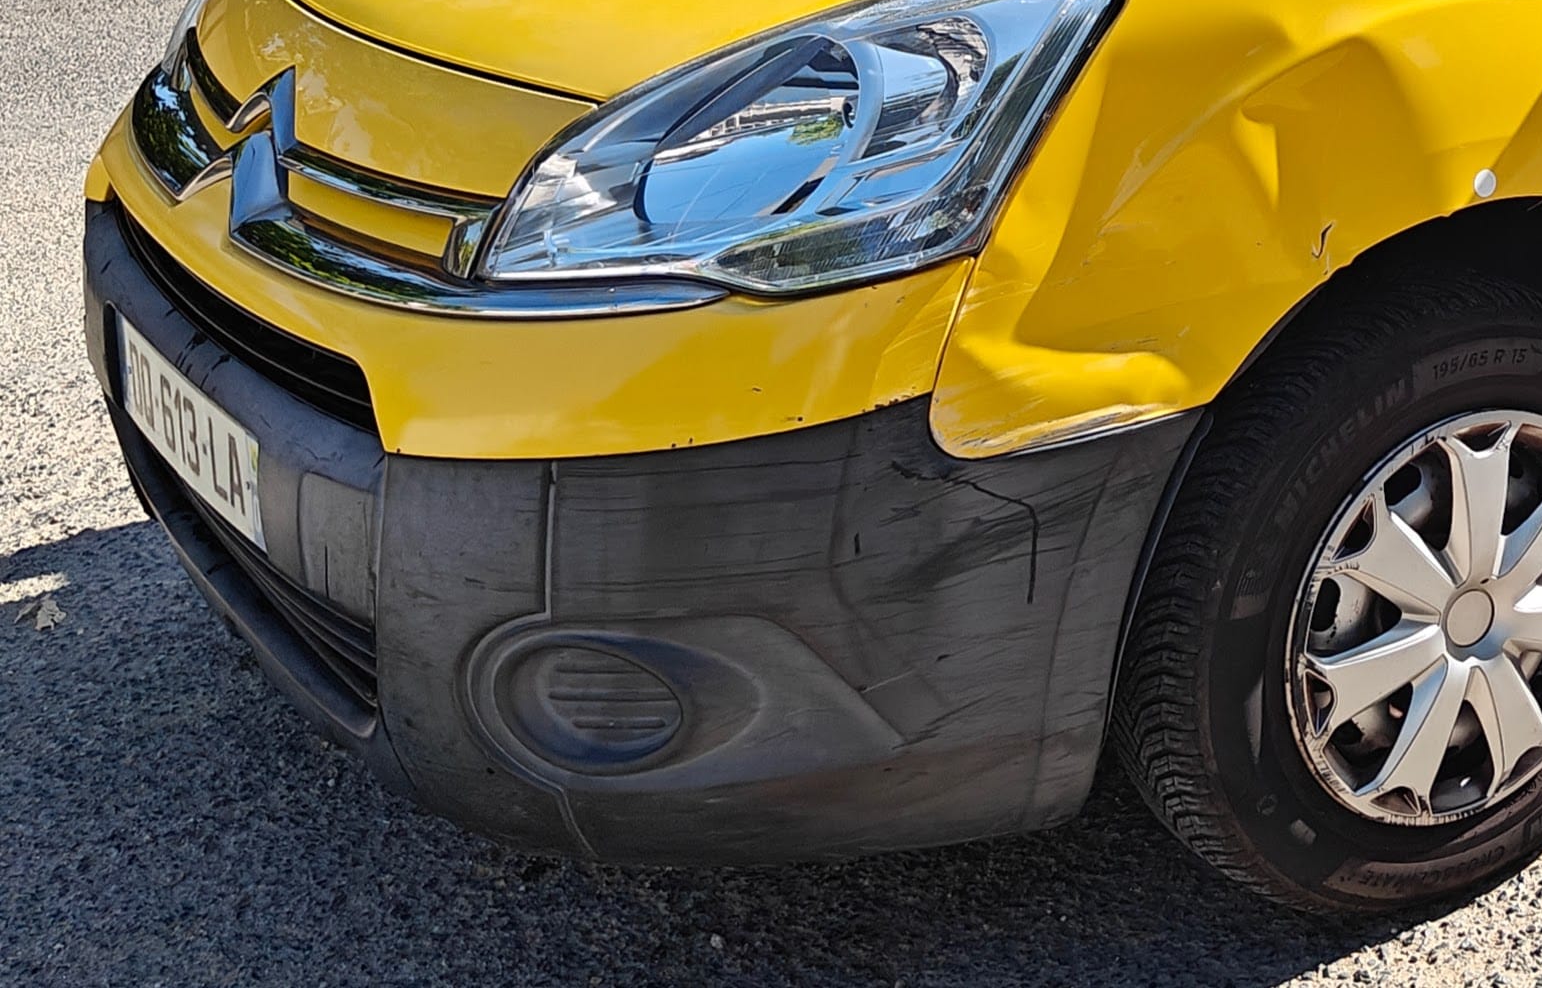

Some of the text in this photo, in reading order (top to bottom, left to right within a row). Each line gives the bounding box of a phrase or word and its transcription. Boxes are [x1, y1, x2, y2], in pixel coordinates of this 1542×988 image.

[1432, 348, 1528, 380] 195/65 R 15
[1275, 378, 1406, 526] MICHELIN
